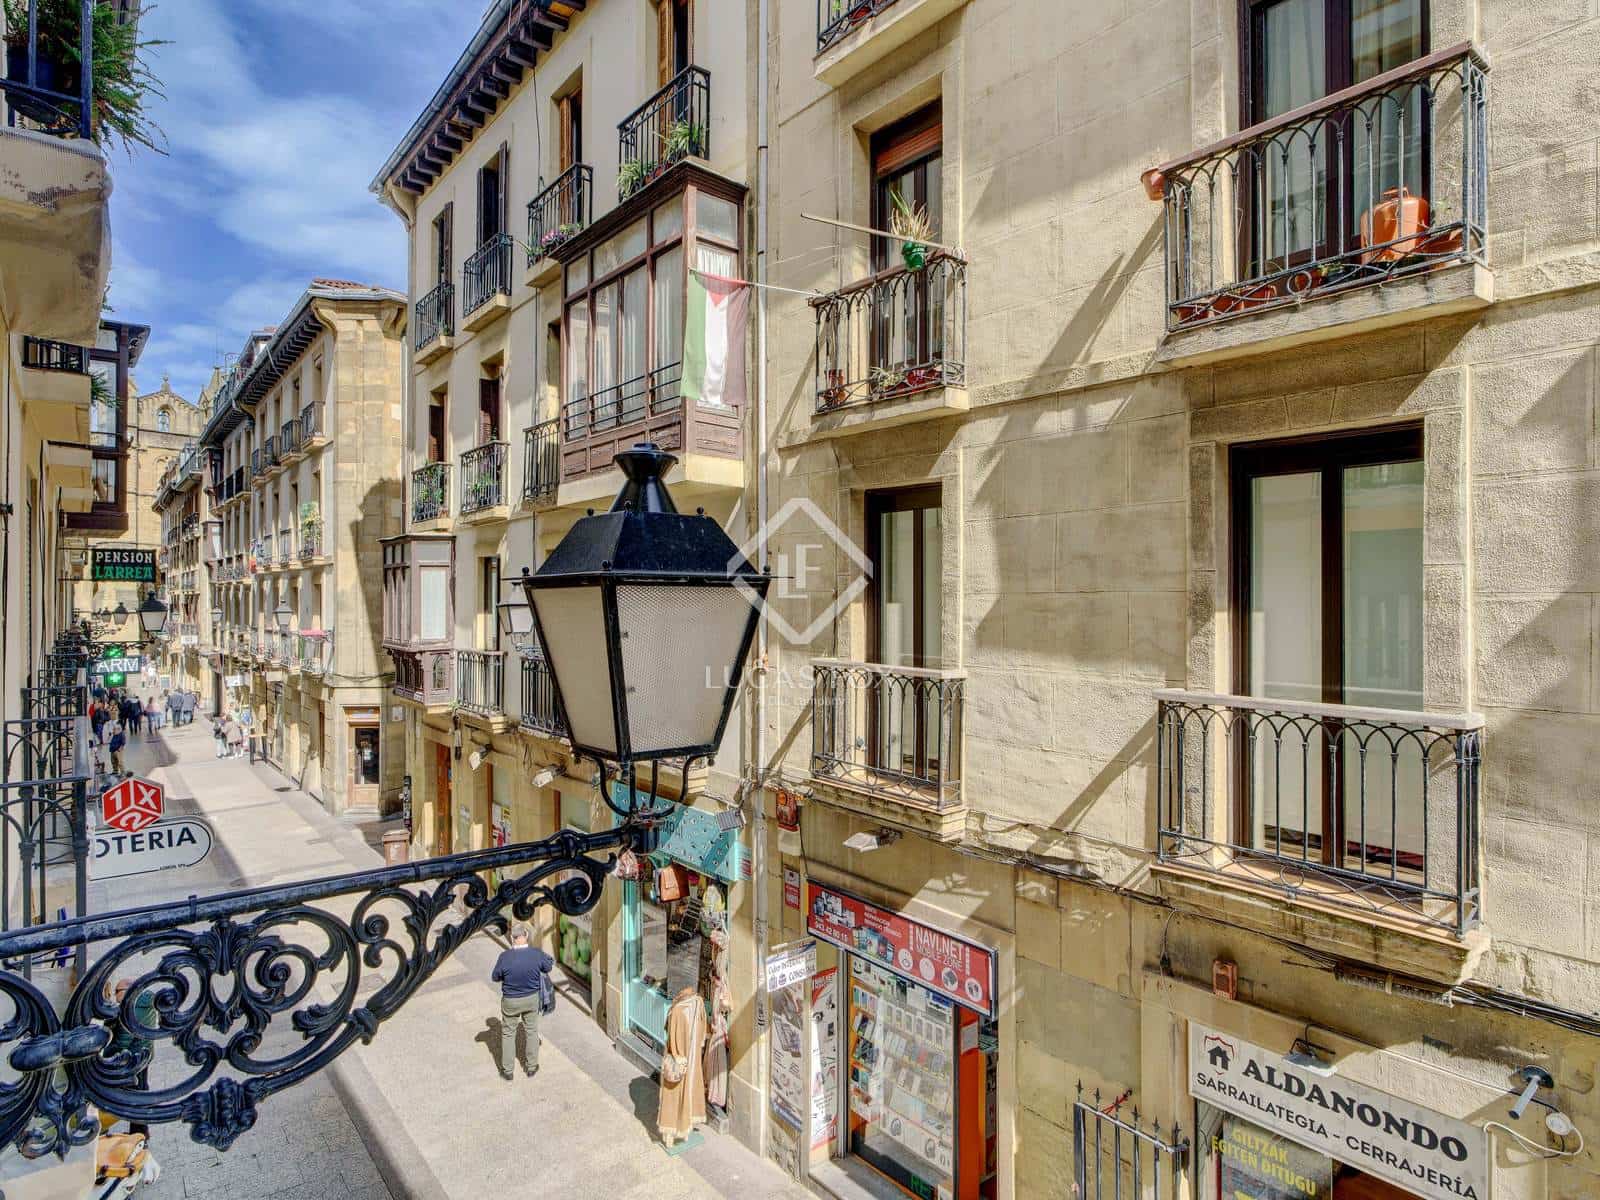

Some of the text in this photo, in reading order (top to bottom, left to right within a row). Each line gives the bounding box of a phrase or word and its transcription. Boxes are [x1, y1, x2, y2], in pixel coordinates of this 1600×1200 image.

[95, 551, 152, 563] PENSION
[95, 565, 153, 579] LARREA
[110, 789, 122, 812] 1
[1242, 1058, 1468, 1162] ALDANONDO
[1197, 1072, 1329, 1138] SARRAILATEGIA
[1346, 1135, 1479, 1200] CERRAJERÍA
[1231, 1128, 1289, 1165] GILTZAK
[1211, 1135, 1316, 1197] EGITEN DITUGU
